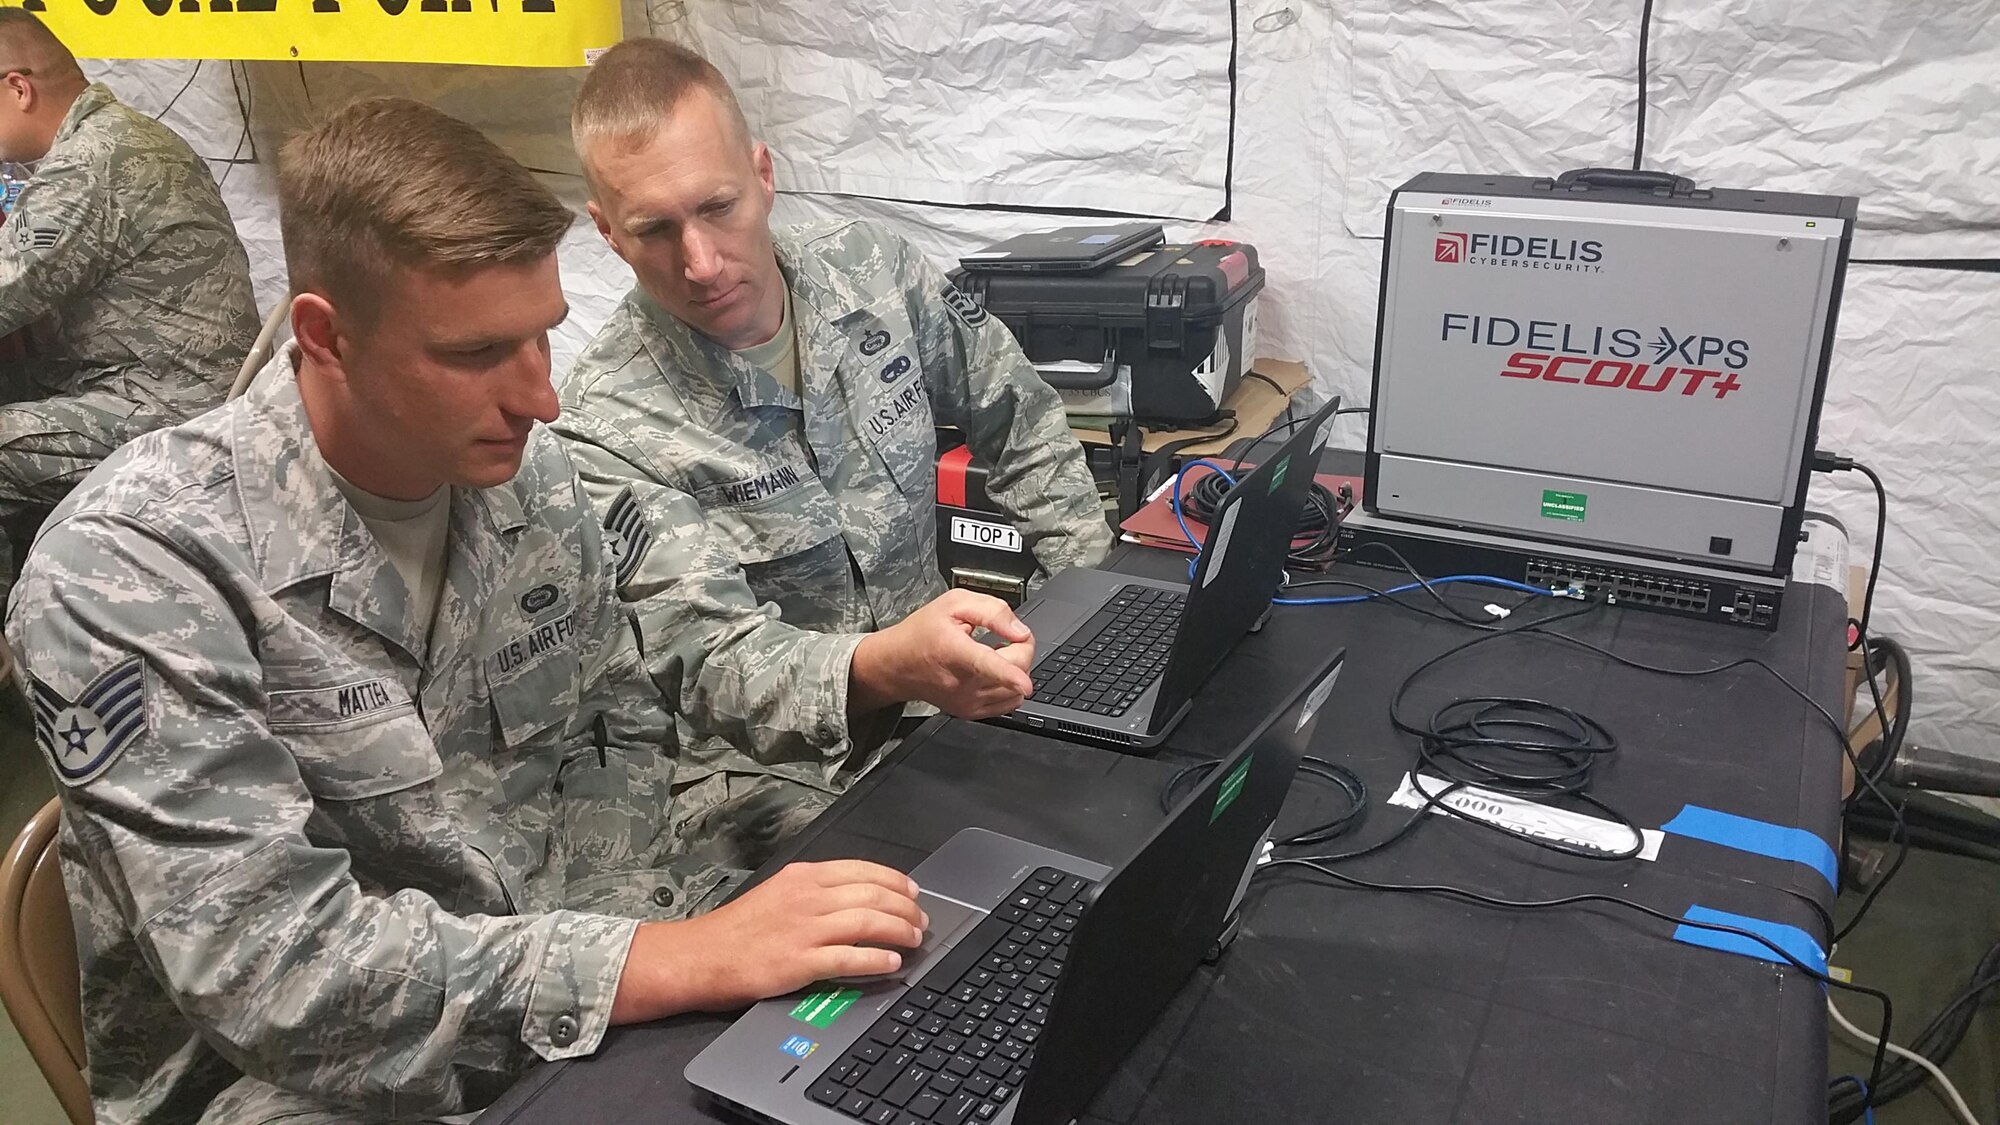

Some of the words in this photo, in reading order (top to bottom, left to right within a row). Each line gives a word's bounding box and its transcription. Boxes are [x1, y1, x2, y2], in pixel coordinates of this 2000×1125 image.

[1451, 197, 1492, 206] FIDELIS
[1469, 256, 1602, 273] CYBERSECURITY
[1471, 233, 1603, 263] FIDELIS
[1441, 313, 1642, 358] FIDELIS
[1500, 352, 1742, 400] SCOUT+
[868, 409, 898, 435] U.S.
[893, 389, 918, 419] AIR
[720, 464, 800, 503] WIEMANN
[971, 524, 1002, 544] TOP
[497, 642, 527, 673] U.S.
[528, 625, 557, 657] AIR
